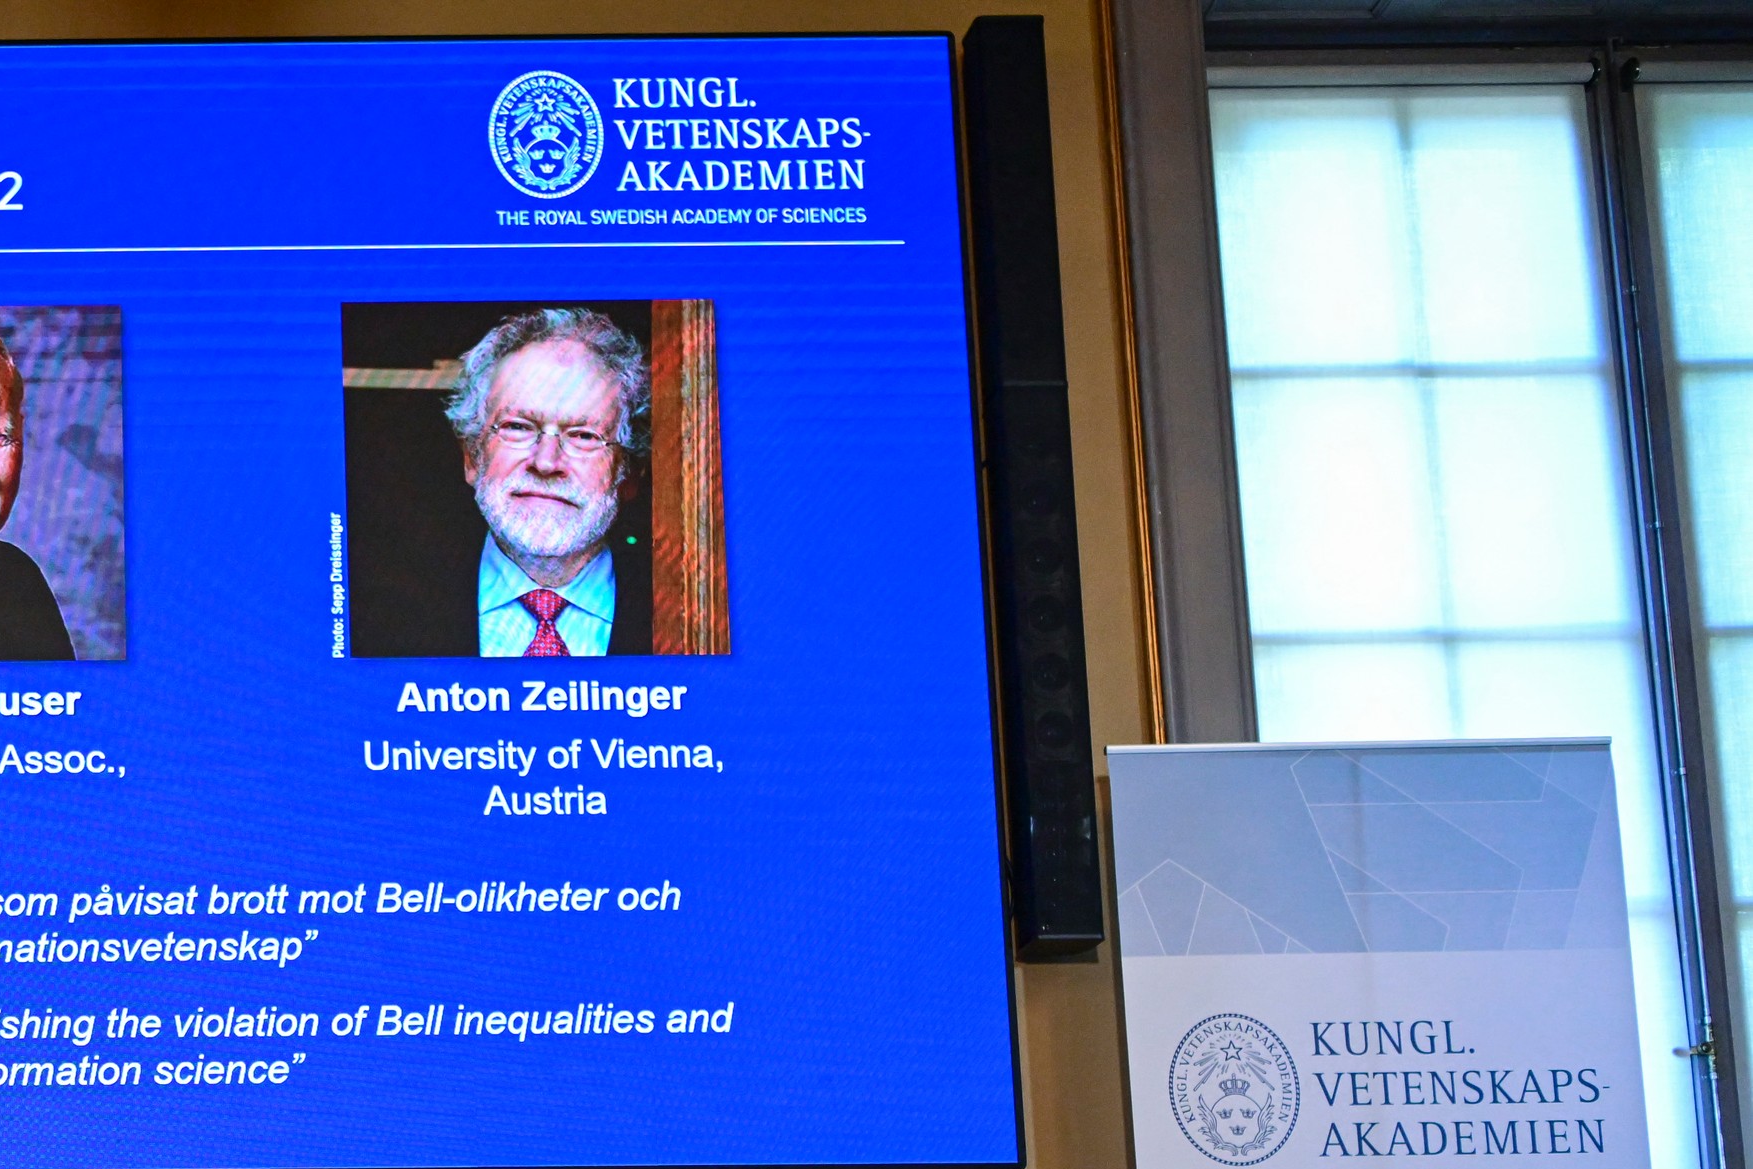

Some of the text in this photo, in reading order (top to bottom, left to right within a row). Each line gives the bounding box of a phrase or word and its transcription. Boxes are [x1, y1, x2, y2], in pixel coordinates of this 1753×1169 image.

[613, 78, 756, 108] KUNGL.
[499, 77, 597, 163] VETENSKAPSAKADEMIEN
[614, 118, 870, 149] VETENSKAPS-
[618, 160, 865, 191] AKADEMIEN
[497, 208, 866, 225] THE ROYAL SWEDISH ACADEMY OF SCIENCES
[331, 584, 345, 614] Sepp
[332, 618, 345, 658] Photo:
[397, 681, 687, 717] Anton Zeilinger
[364, 739, 723, 776] University of Vienna,
[484, 785, 607, 815] Austria
[69, 884, 198, 923] påvisat
[208, 884, 289, 914] brott
[299, 884, 366, 913] mot
[376, 881, 609, 913] Bell-olikheter
[618, 880, 681, 910] och
[107, 1008, 161, 1038] the
[175, 1006, 318, 1037] violation
[332, 1005, 369, 1036] of
[377, 1005, 444, 1035] Bell
[454, 1003, 655, 1042] inequalities
[667, 1002, 734, 1033] and
[1310, 1020, 1475, 1056] KUNGL.
[154, 1053, 306, 1084] science”
[1177, 1021, 1292, 1123] KUNGL. VETENSKAPSAKADEMIEN
[1313, 1068, 1610, 1106] VETENSKAPS-
[1319, 1119, 1605, 1157] AKADEMIEN
